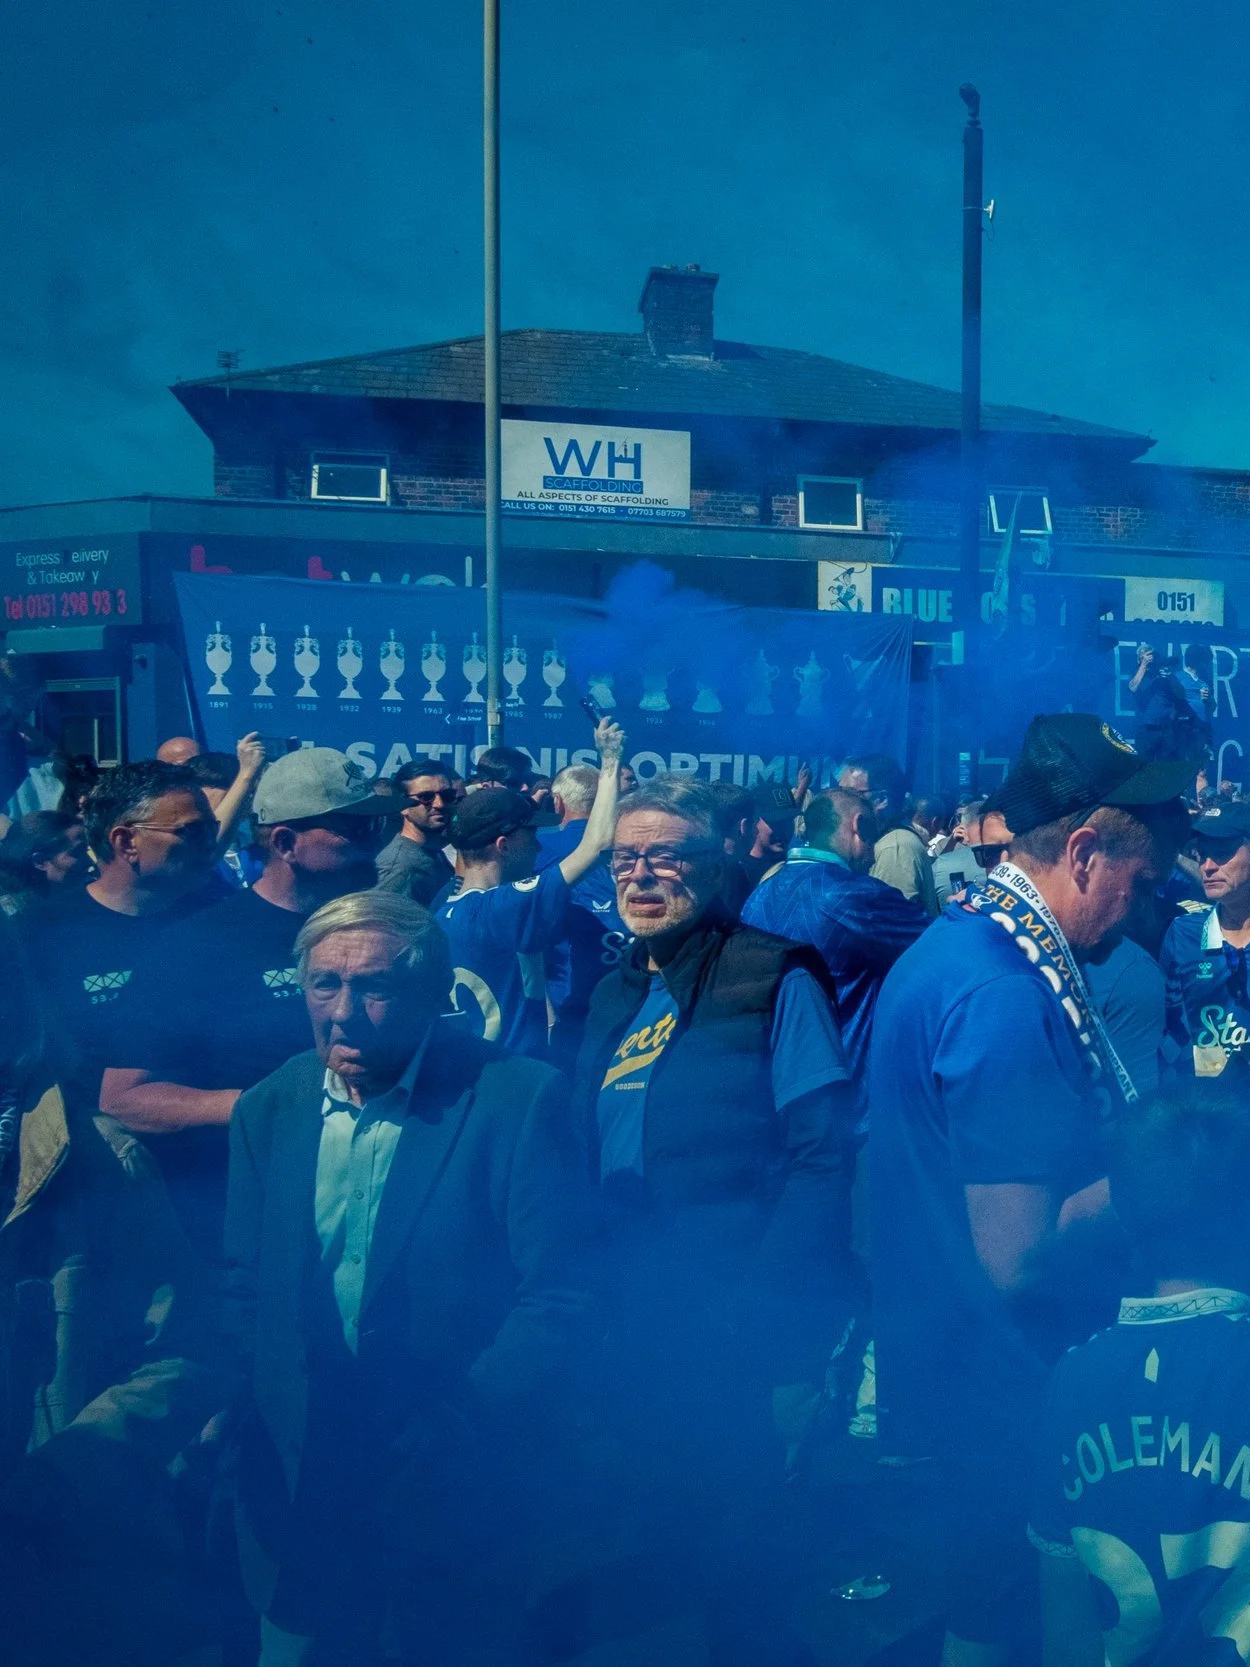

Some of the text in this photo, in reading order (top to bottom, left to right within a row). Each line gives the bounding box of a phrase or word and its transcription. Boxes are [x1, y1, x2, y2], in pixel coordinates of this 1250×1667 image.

[543, 437, 641, 479] WH
[545, 478, 642, 493] SCAFFOLDING
[517, 490, 669, 506] ALL ASPECTS OF SCAFFOLDING
[523, 502, 536, 511] US
[559, 504, 577, 512] 0151
[578, 505, 595, 513] 430
[598, 506, 616, 514] 7615
[628, 507, 654, 516] 07703
[655, 509, 686, 517] 687579
[16, 548, 110, 568] Express elivery
[27, 569, 99, 585] & Takeawy
[4, 594, 23, 619] Tel
[882, 587, 953, 623] BLUE
[1157, 591, 1195, 612] 0151
[209, 702, 229, 710] 1891
[253, 703, 274, 711] 1915
[339, 705, 360, 713] 1932
[382, 706, 402, 714] 1939
[423, 707, 443, 715] 1963
[544, 712, 563, 720] 1987
[1010, 873, 1039, 900] 1963
